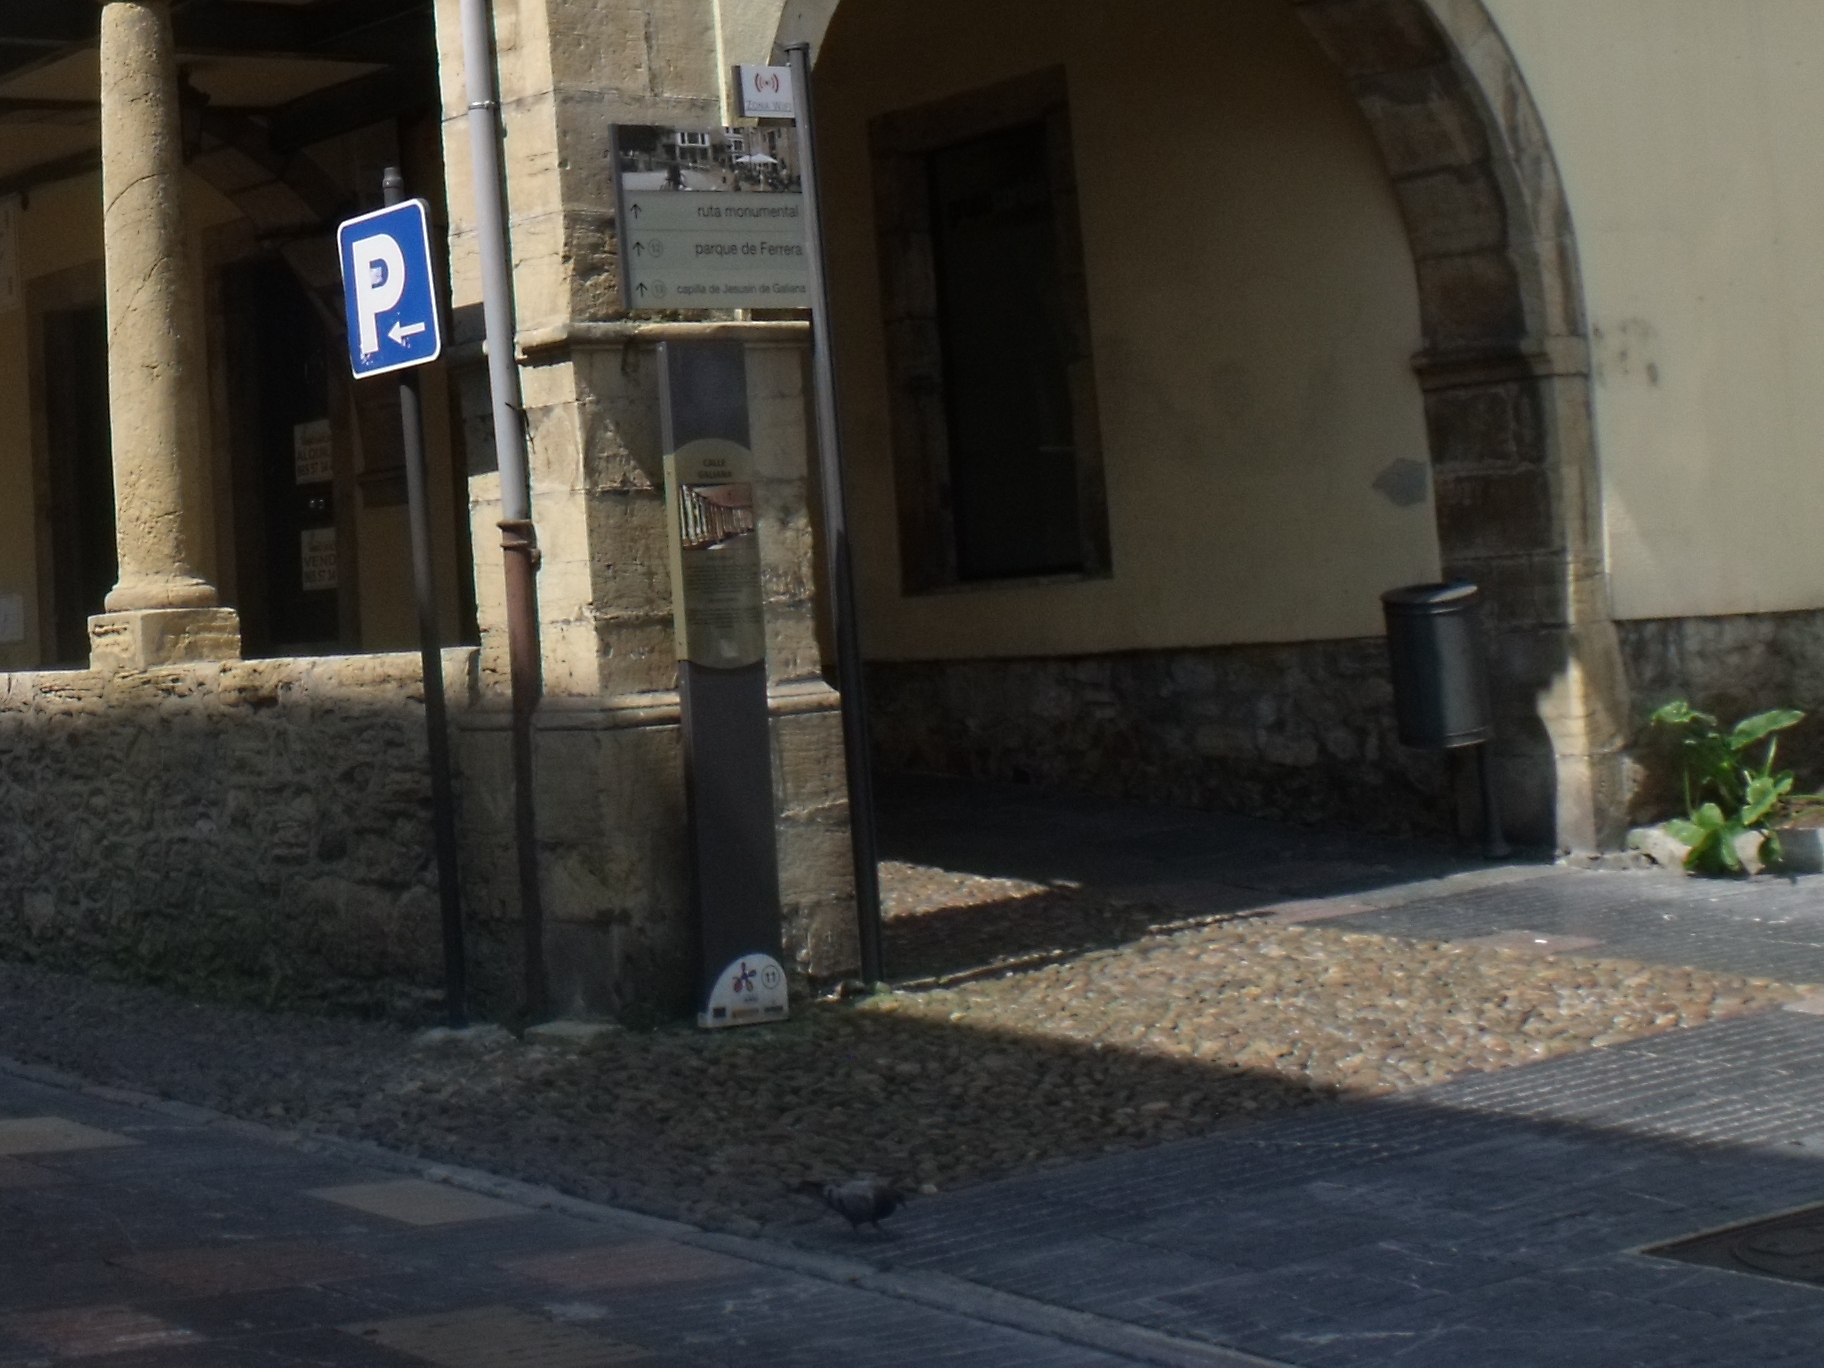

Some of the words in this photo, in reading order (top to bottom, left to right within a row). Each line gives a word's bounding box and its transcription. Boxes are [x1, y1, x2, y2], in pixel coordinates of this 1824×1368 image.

[697, 206, 721, 218] ruta
[725, 204, 799, 218] monumental
[695, 243, 738, 257] parque
[742, 242, 756, 255] de
[760, 241, 803, 256] Ferrera
[352, 233, 406, 352] P
[677, 283, 706, 295] capilla
[709, 284, 721, 294] de
[759, 284, 771, 294] de
[772, 283, 806, 294] Galiana
[702, 458, 726, 467] CALLE
[765, 971, 776, 983] 11
